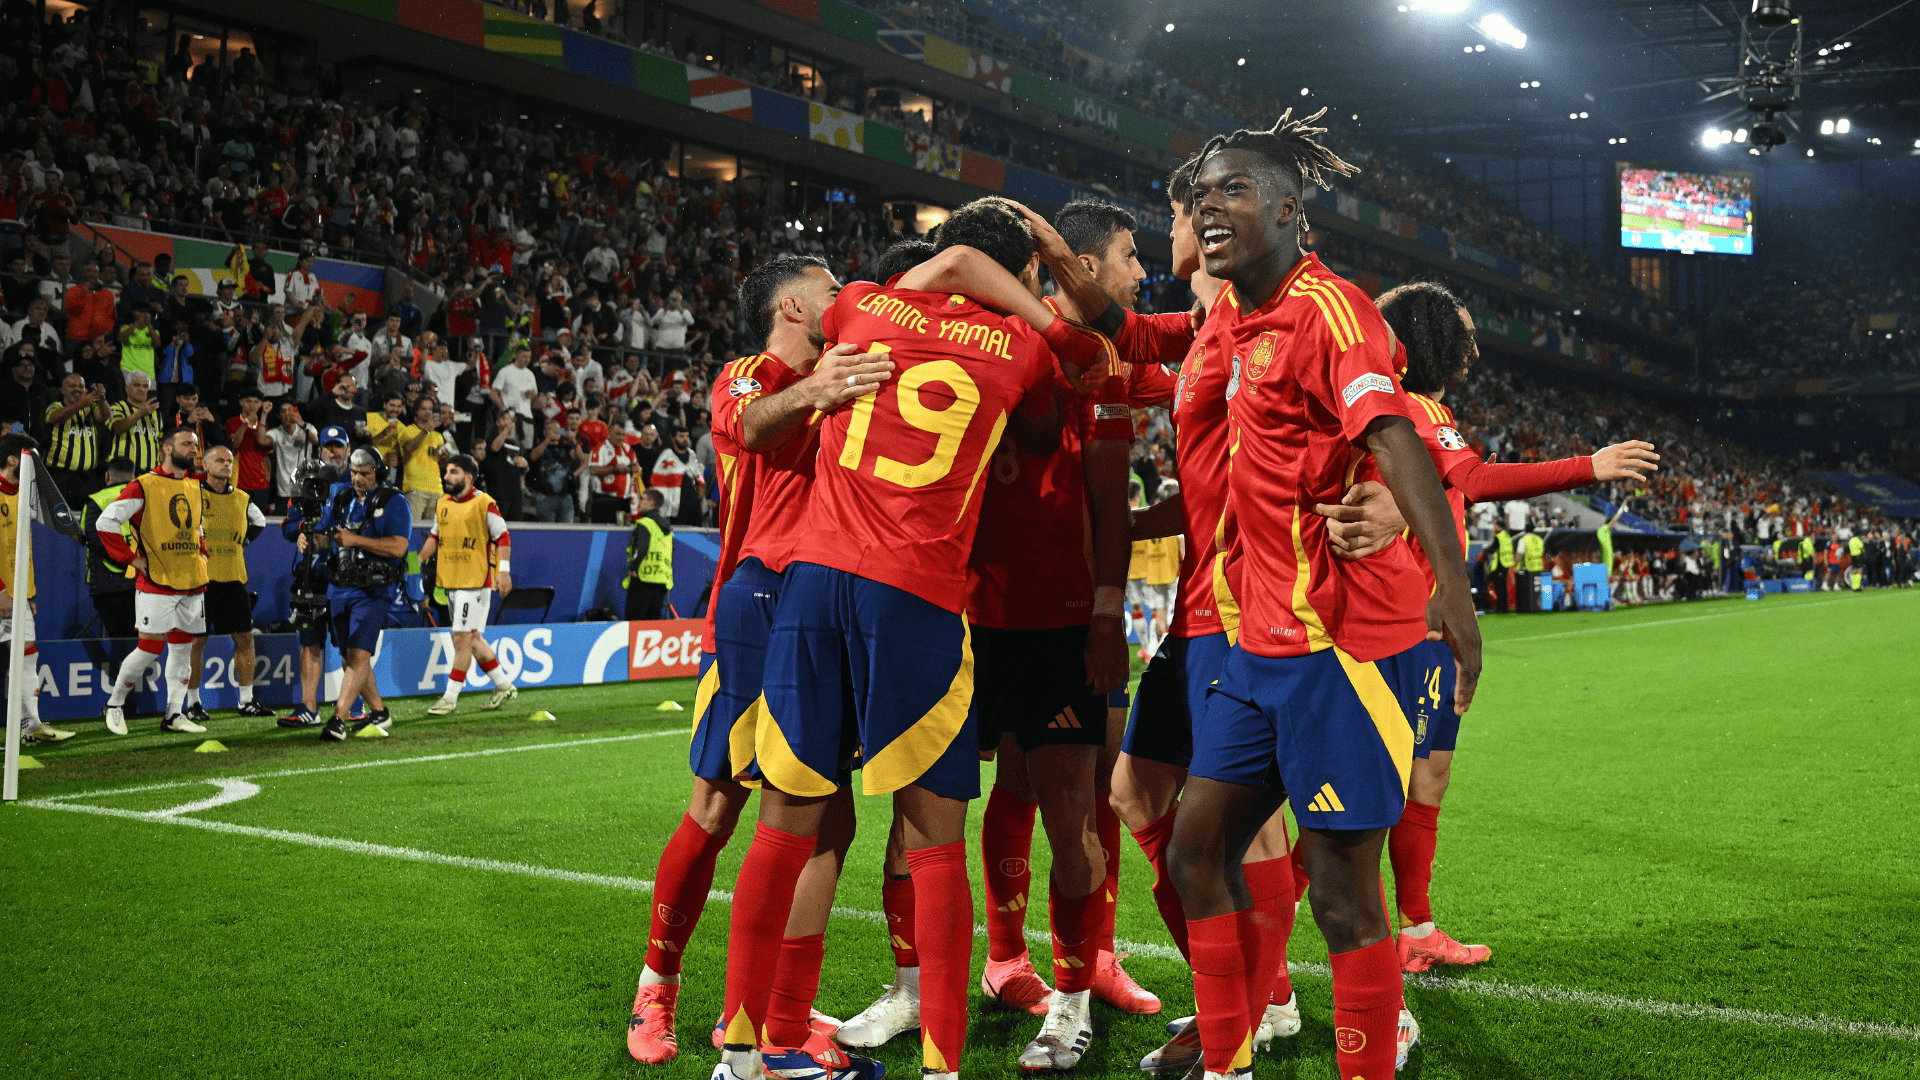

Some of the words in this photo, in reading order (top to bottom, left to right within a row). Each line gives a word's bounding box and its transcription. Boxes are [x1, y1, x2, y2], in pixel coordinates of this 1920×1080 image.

[1073, 96, 1118, 130] KÖLN
[856, 292, 933, 335] LAMINE
[938, 319, 1013, 361] YAMAL
[1345, 378, 1393, 401] FOUNDATION
[839, 341, 981, 488] 19
[462, 602, 469, 618] 9
